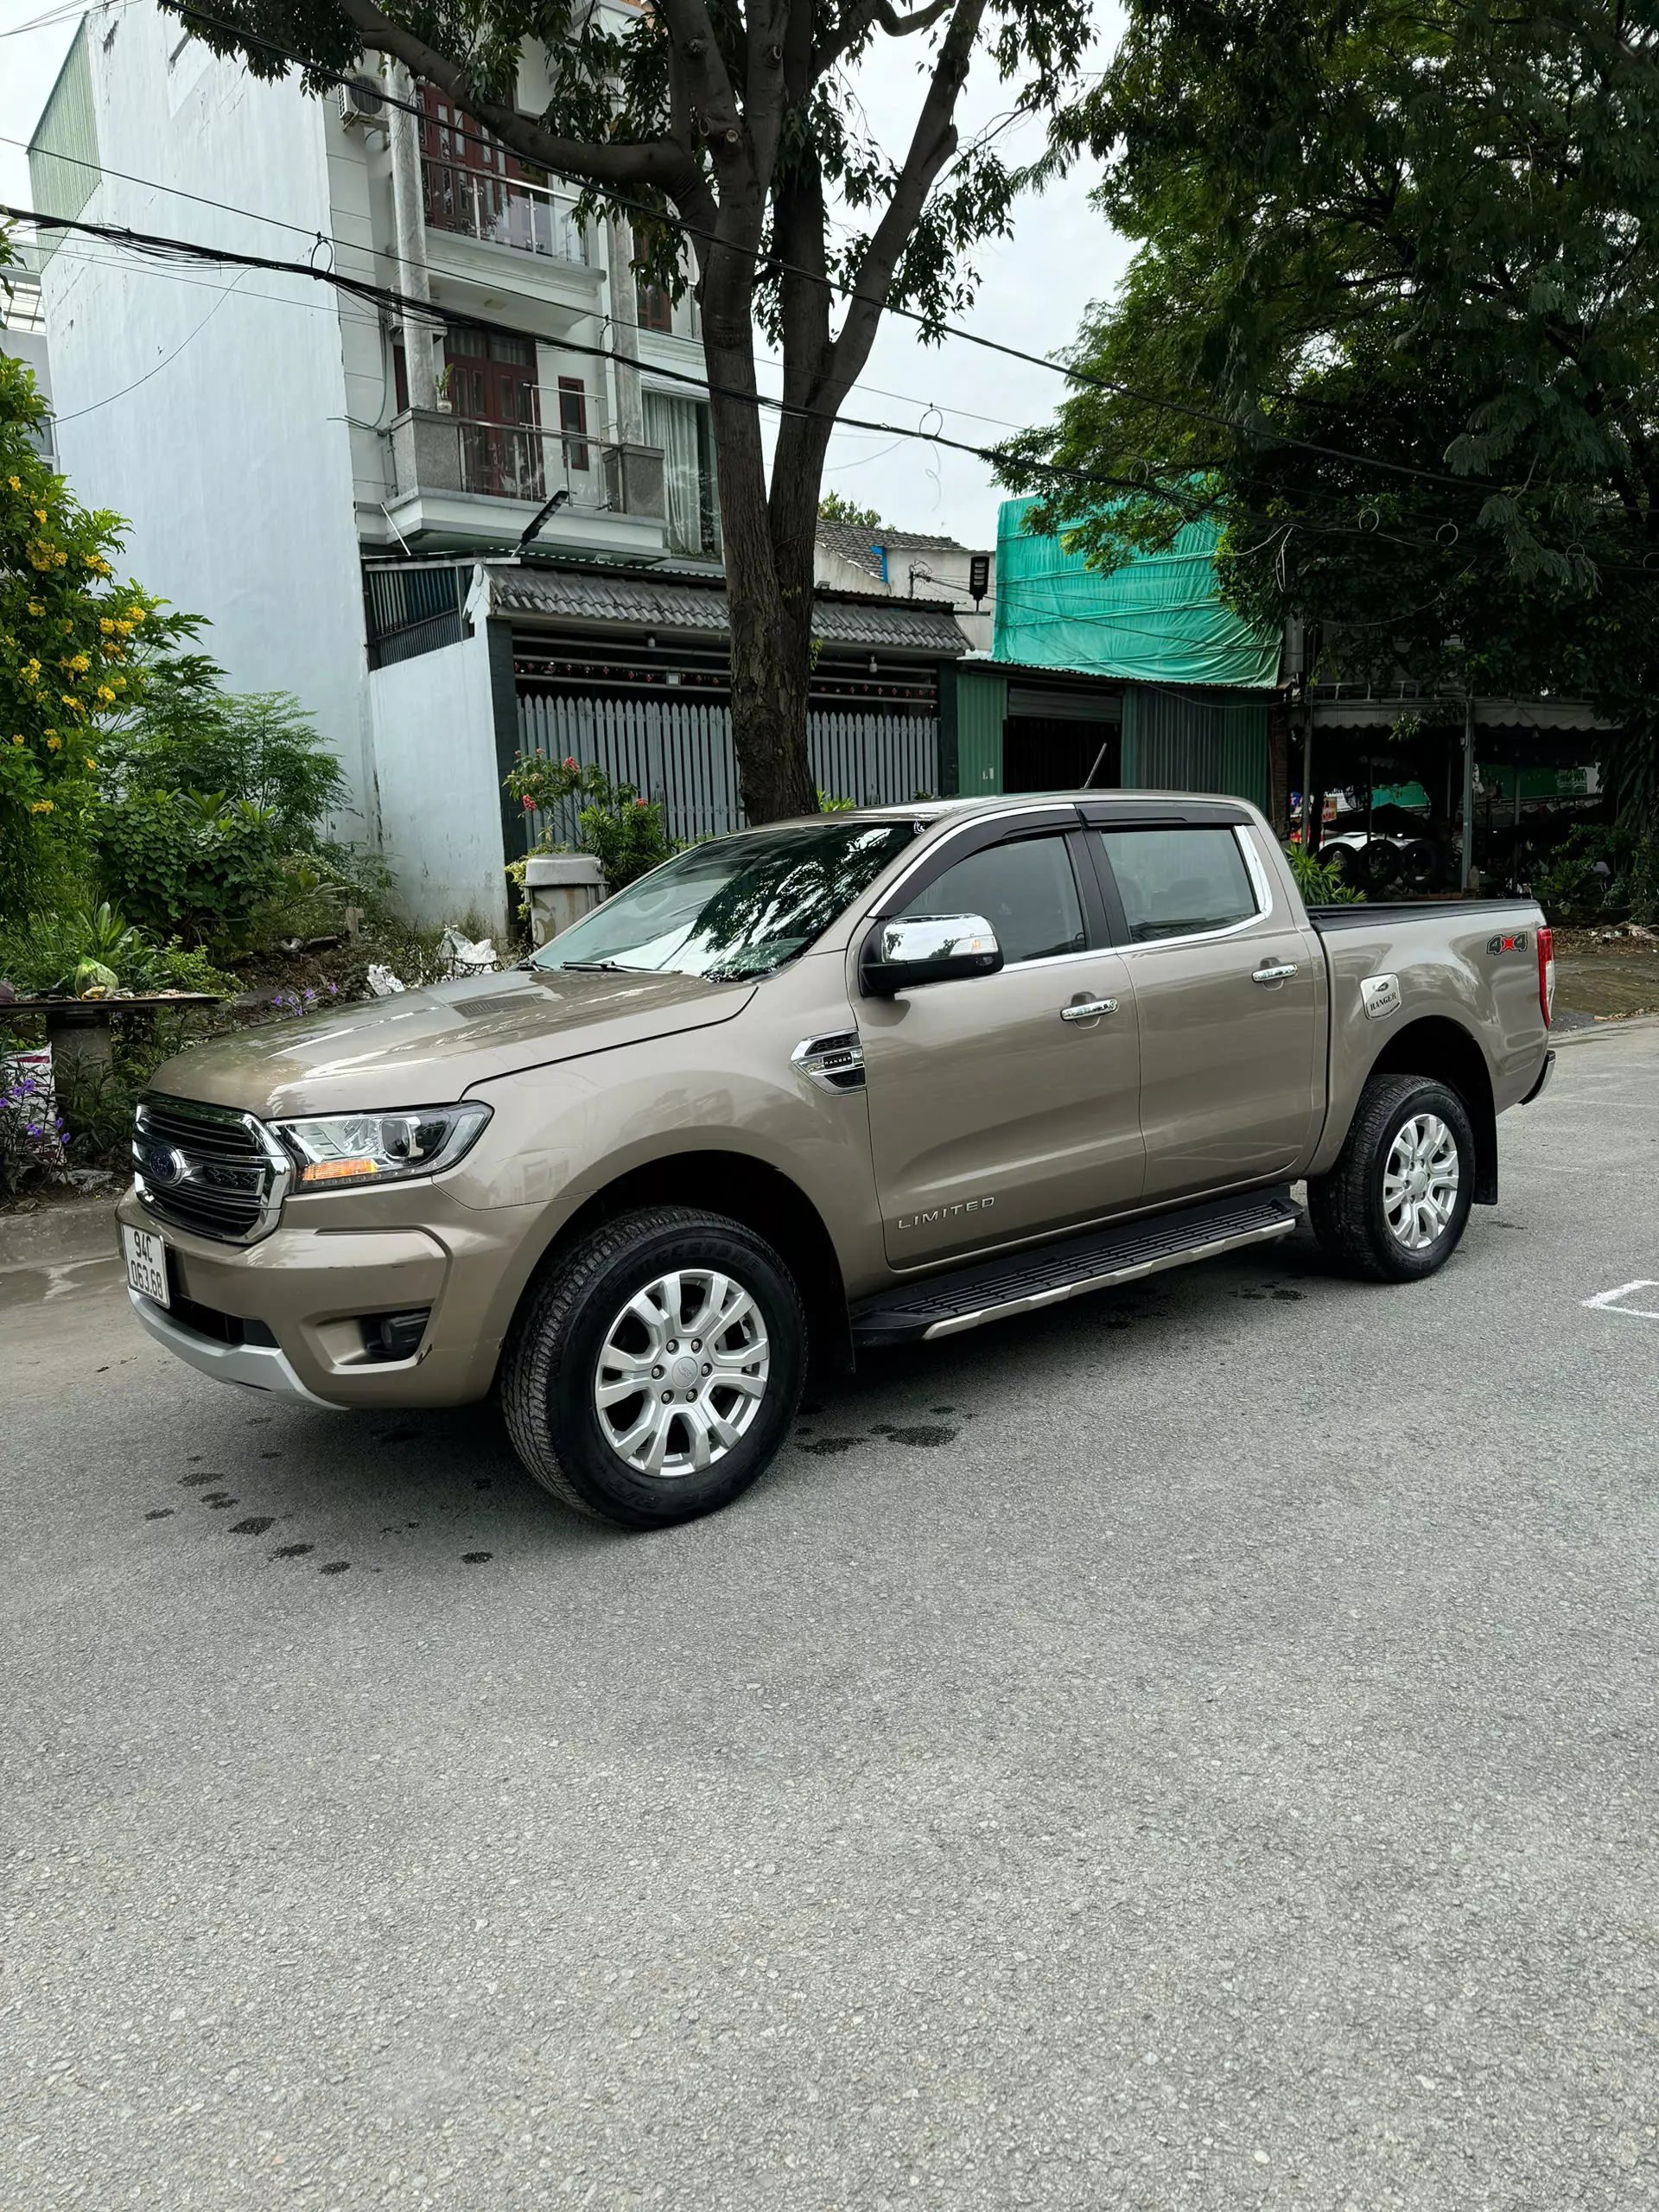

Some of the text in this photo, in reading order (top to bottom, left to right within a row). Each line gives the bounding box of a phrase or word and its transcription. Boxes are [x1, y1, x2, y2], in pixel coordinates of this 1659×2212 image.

[1370, 992, 1397, 1011] RANGER
[824, 1056, 852, 1065] RANGER
[898, 1197, 995, 1230] LIMITED
[133, 1230, 153, 1263] 94C
[130, 1260, 163, 1300] 063.68
